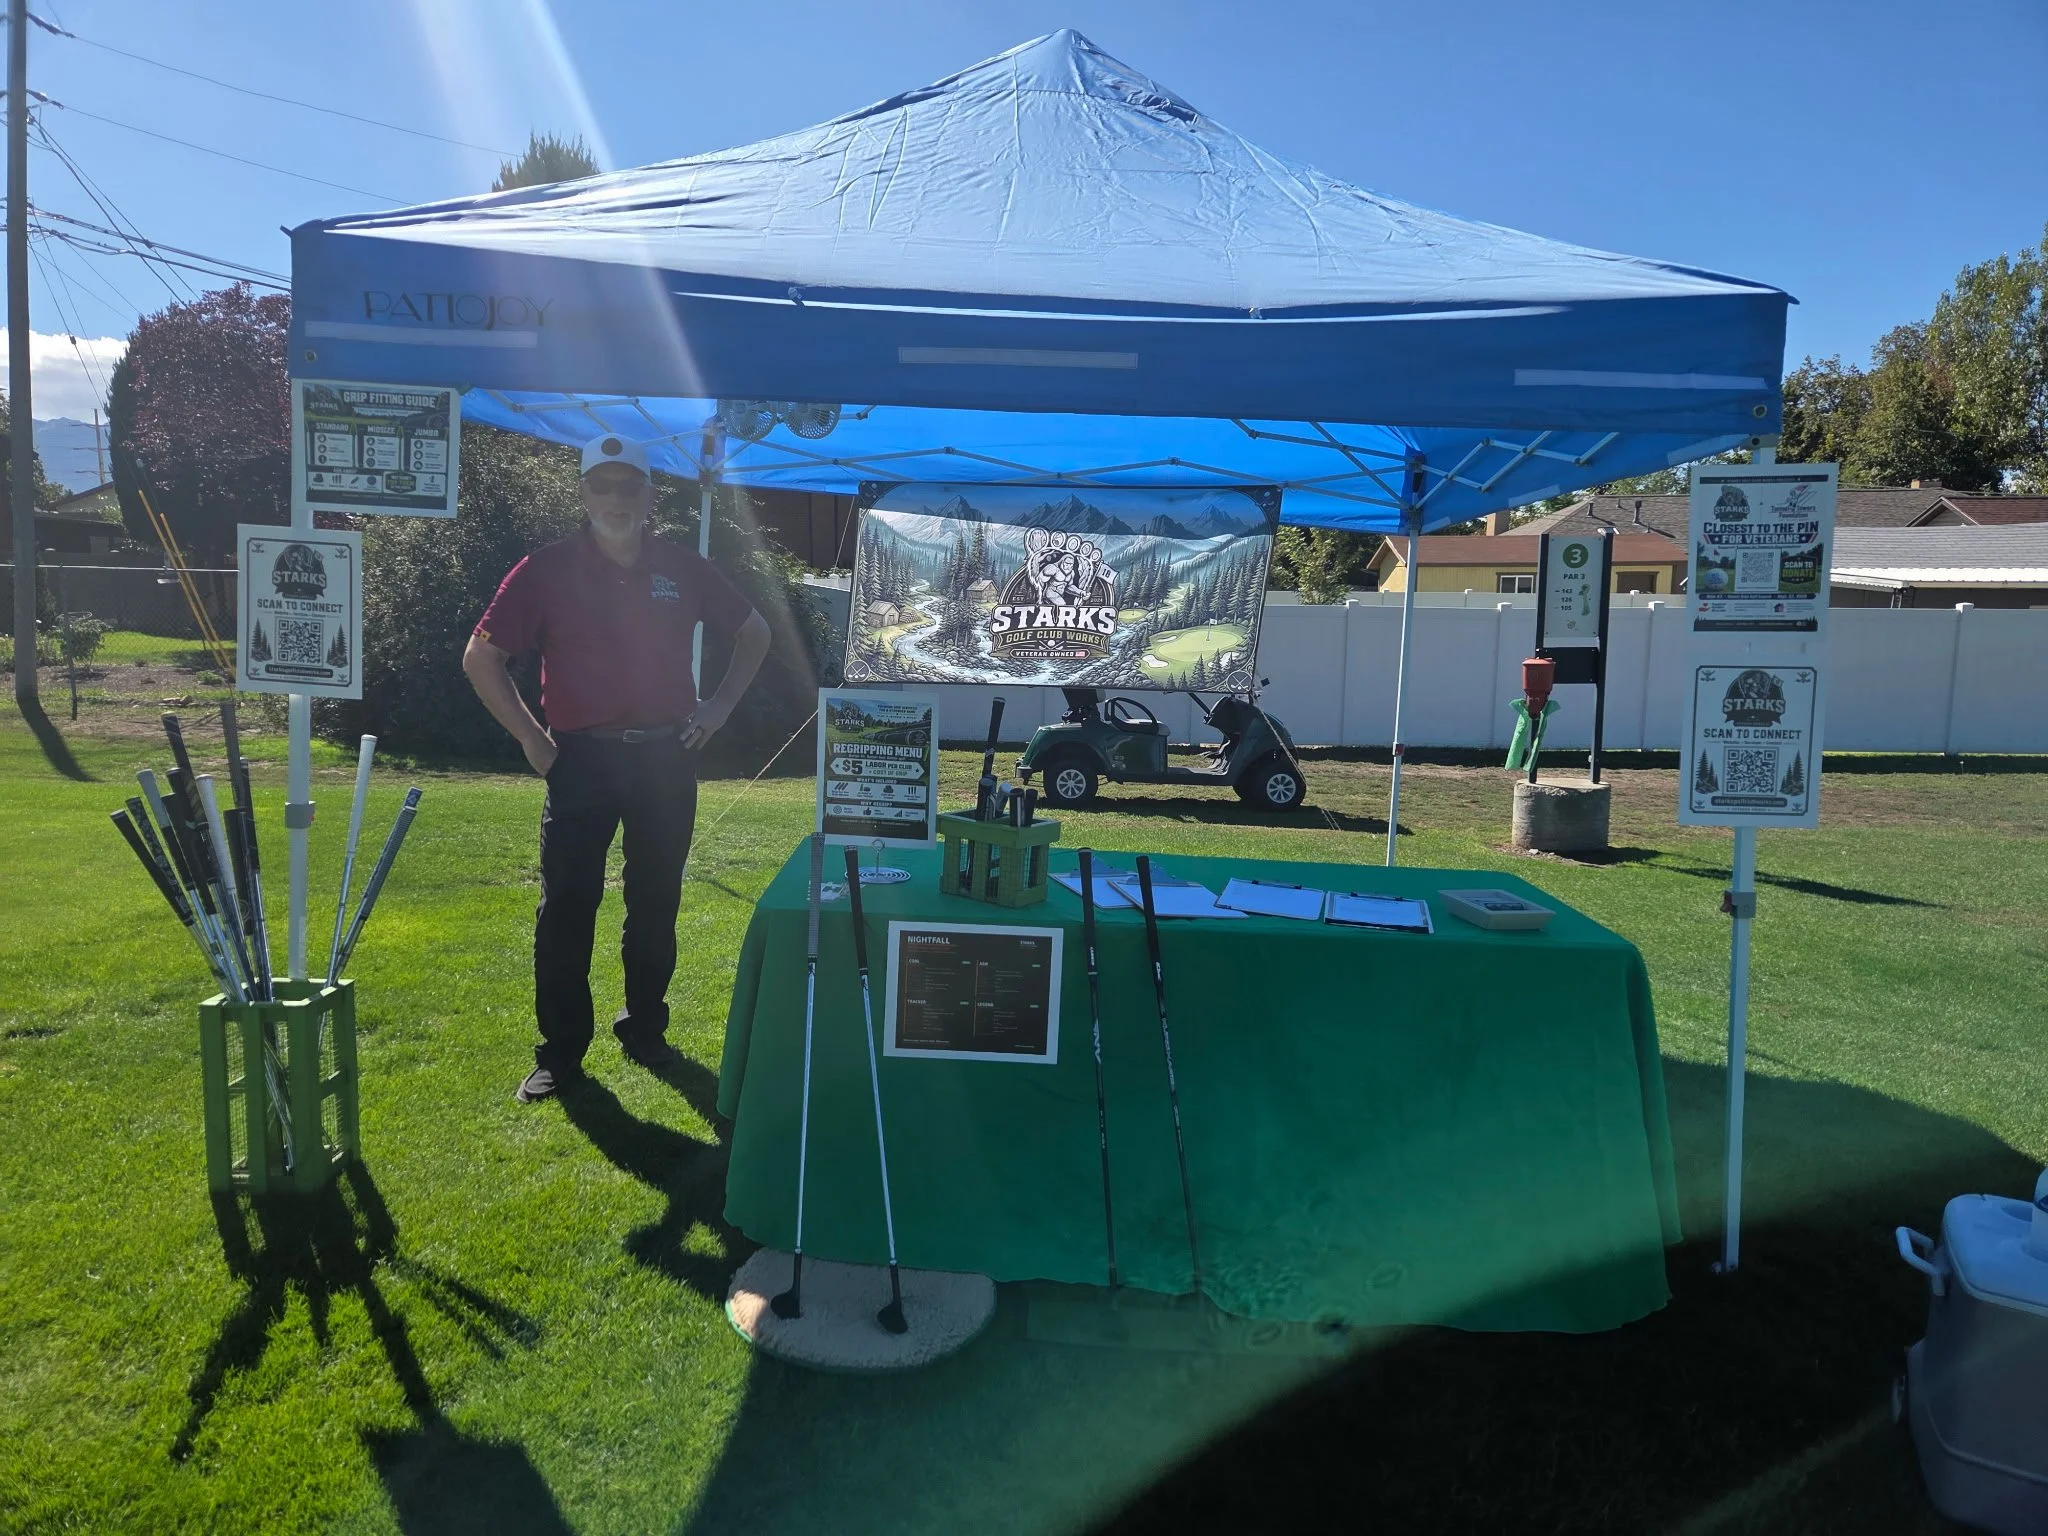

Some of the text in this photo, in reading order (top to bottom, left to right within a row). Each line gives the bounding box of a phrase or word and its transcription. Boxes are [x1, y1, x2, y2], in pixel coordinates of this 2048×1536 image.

[363, 291, 553, 331] PATIOJOY
[343, 391, 367, 403] GRIP
[369, 393, 404, 405] FITTING
[405, 395, 437, 408] GUIDE
[367, 425, 396, 434] MIDSIZE
[1714, 506, 1750, 514] STARKS
[1704, 520, 1819, 534] CLOSEST TO THE PIN
[1722, 534, 1800, 544] FOR VETERANS
[1570, 548, 1582, 564] 3
[1784, 561, 1803, 569] SCAN
[273, 571, 326, 588] STARKS
[1102, 569, 1111, 579] 18
[1782, 569, 1814, 577] DONATE
[257, 598, 344, 613] SCAN TO CONNECT
[992, 606, 1116, 635] STARKS
[1006, 630, 1100, 644] GOLF CLUB WORKS
[1723, 698, 1785, 713] STARKS
[835, 718, 865, 727] STARKS
[1703, 728, 1802, 740] SCAN TO CONNECT
[833, 743, 893, 756] REGRIPPING
[894, 746, 923, 758] MENU
[842, 759, 863, 775] $5
[907, 935, 951, 945] NIGHTFALL
